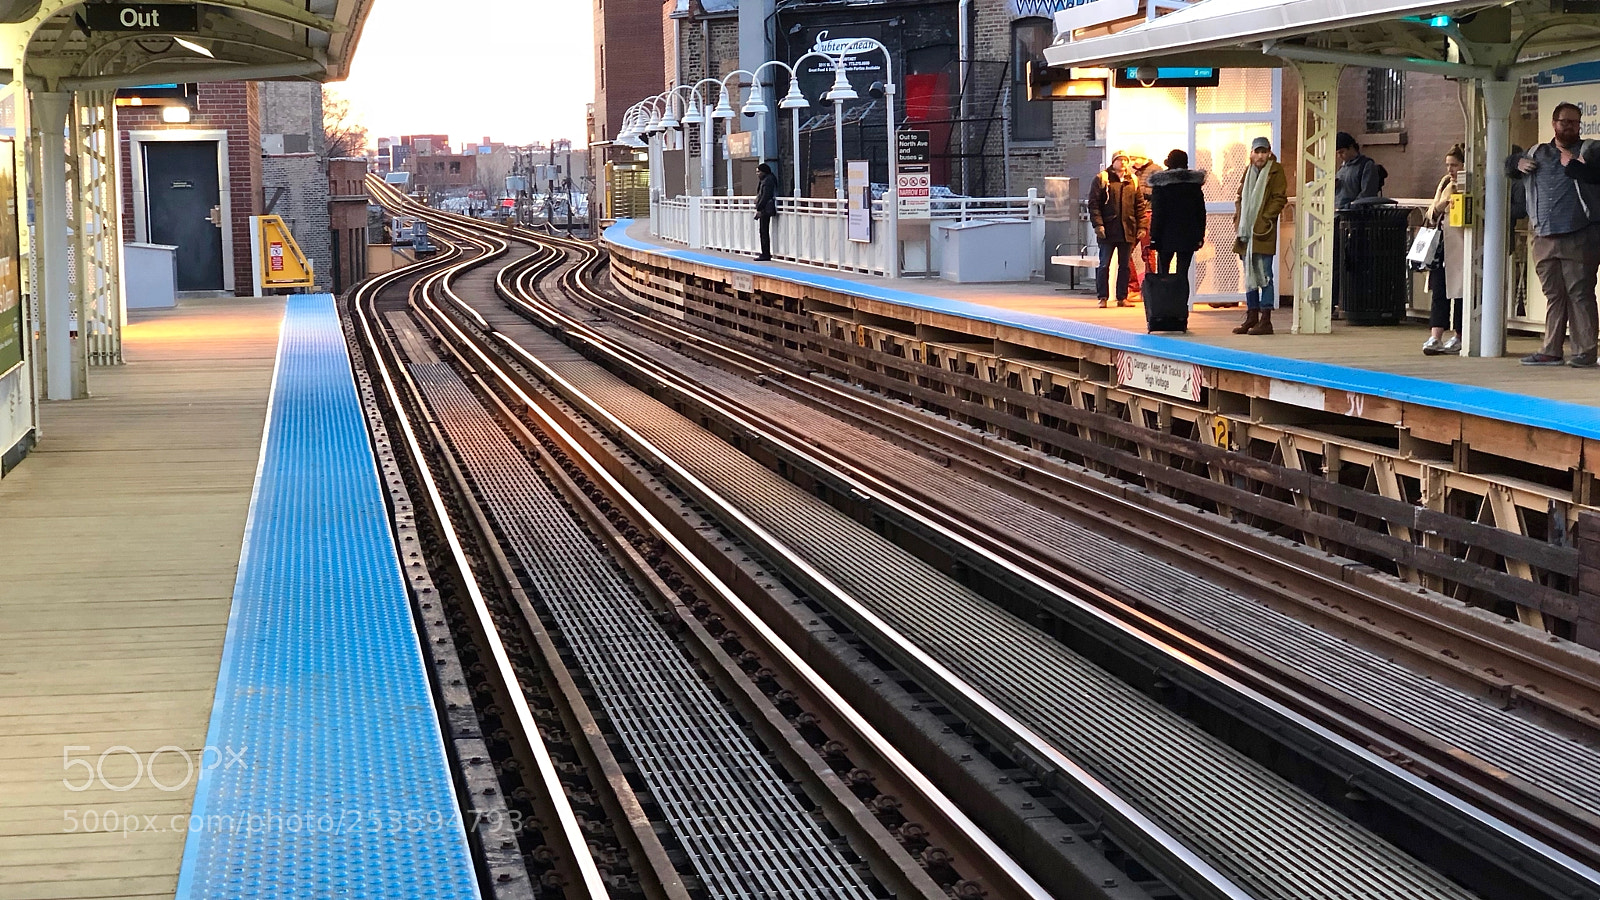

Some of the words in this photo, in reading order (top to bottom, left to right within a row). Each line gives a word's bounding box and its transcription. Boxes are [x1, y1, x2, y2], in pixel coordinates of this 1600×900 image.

[119, 7, 160, 27] Out
[1577, 100, 1598, 116] Blue
[899, 188, 919, 196] NARROW
[918, 188, 928, 196] EXIT
[1134, 358, 1148, 373] Danger
[1150, 362, 1161, 375] Keep
[1168, 364, 1182, 378] Tracks
[1145, 373, 1154, 387] High
[1155, 377, 1170, 391] Voltage
[1217, 420, 1227, 448] 2
